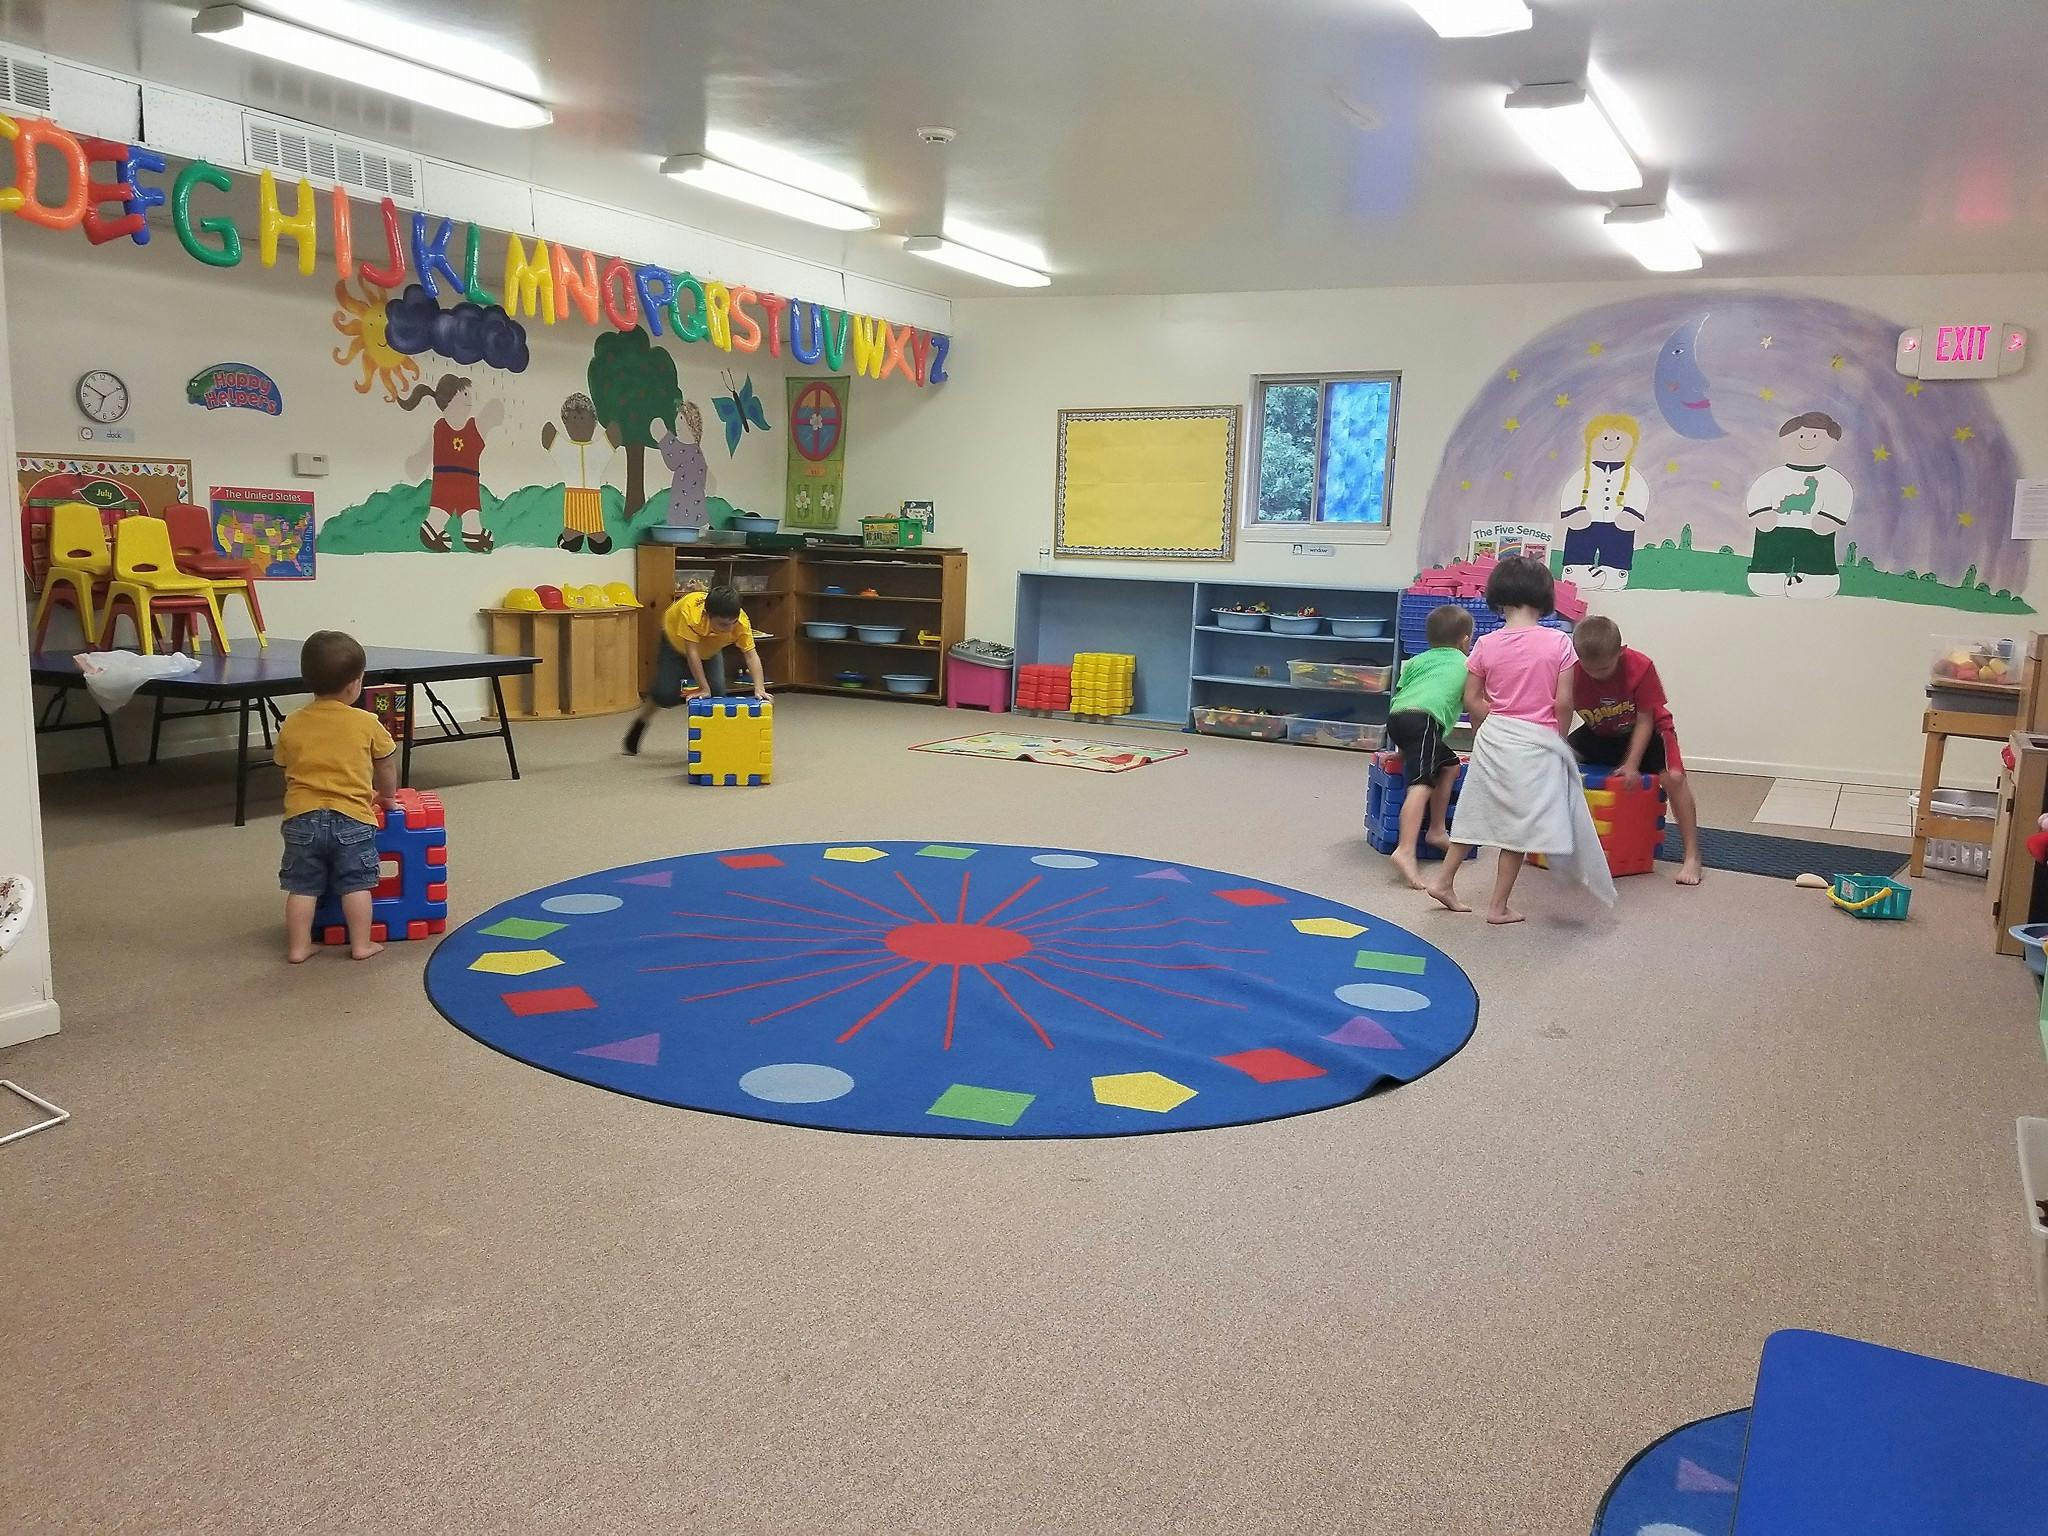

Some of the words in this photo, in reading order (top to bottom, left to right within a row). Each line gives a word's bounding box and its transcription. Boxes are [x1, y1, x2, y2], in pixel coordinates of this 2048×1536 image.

[14, 117, 88, 230] D
[79, 138, 145, 246] E
[116, 144, 166, 246] F
[172, 160, 242, 268] G
[260, 168, 317, 276] H
[333, 184, 352, 279] I
[360, 197, 406, 288] J
[412, 212, 465, 298] K
[464, 222, 497, 305] L
[504, 231, 555, 325] M
[552, 243, 599, 325] N
[600, 257, 638, 332] O
[636, 264, 676, 336] P
[667, 271, 710, 342] Q
[705, 281, 732, 352] R
[730, 285, 762, 353] S
[757, 292, 788, 358] T
[790, 298, 822, 365] U
[821, 304, 849, 371] V
[853, 313, 887, 379] W
[880, 321, 916, 381] X
[910, 325, 932, 387] Y
[930, 336, 949, 384] Z
[1936, 326, 1991, 362] EXIT
[214, 371, 272, 396] Happy
[204, 387, 277, 415] Helpers
[95, 488, 113, 500] July
[225, 489, 242, 499] The
[244, 491, 273, 501] United
[275, 492, 301, 502] States
[1473, 529, 1493, 540] The
[1494, 524, 1514, 535] Five
[1516, 525, 1552, 542] Senses
